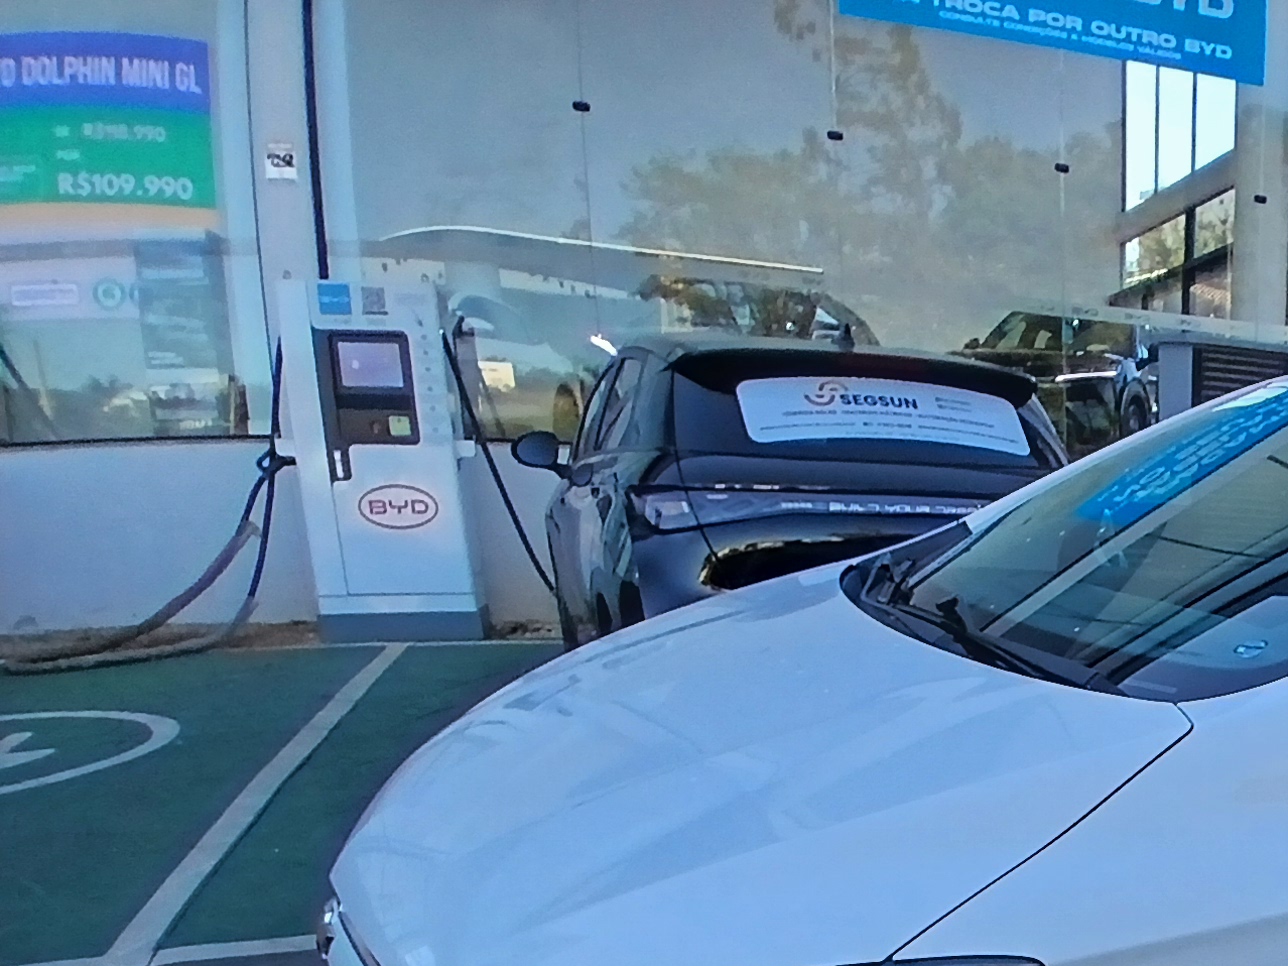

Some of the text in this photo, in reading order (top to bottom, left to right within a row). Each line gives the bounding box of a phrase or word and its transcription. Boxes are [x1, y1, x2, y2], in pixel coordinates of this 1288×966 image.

[1028, 8, 1082, 31] POR
[1091, 20, 1177, 48] OUTRO
[1184, 38, 1232, 60] BYD
[21, 55, 116, 86] DOLPHIN
[121, 57, 170, 89] MINI
[175, 62, 203, 94] GL
[57, 171, 194, 201] R$109.990
[840, 393, 919, 411] SEGSUN
[368, 499, 429, 515] BYD
